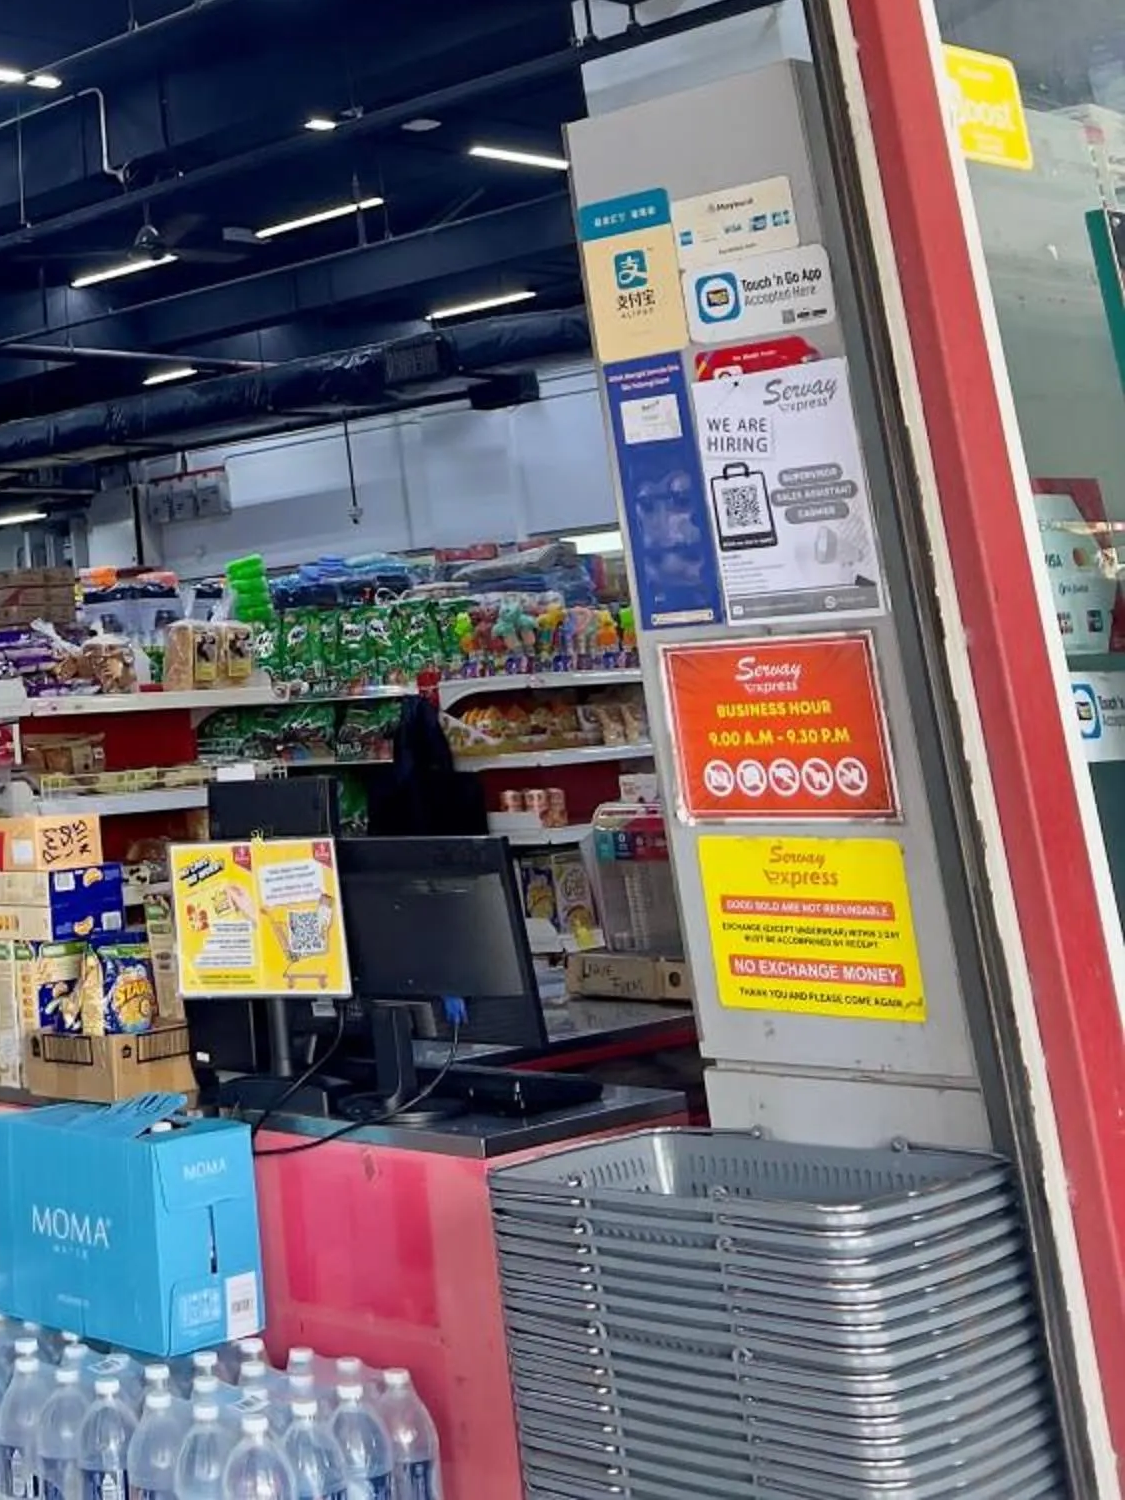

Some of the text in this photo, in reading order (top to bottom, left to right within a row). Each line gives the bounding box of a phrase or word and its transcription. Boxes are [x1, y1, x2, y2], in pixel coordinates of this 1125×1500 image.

[741, 276, 772, 292] Touch
[802, 267, 822, 283] App
[793, 285, 817, 299] Here
[763, 376, 838, 406] Servay
[706, 417, 767, 433] WE ARE
[707, 436, 769, 454] HIRING
[734, 656, 803, 682] Servay
[716, 700, 833, 719] BUSINESS HOUR
[769, 846, 826, 868] Servay
[734, 958, 899, 984] NO EXCHANGE MONEY
[769, 989, 788, 999] YOU
[184, 1157, 226, 1181] MOMA
[31, 1204, 110, 1249] MOMA
